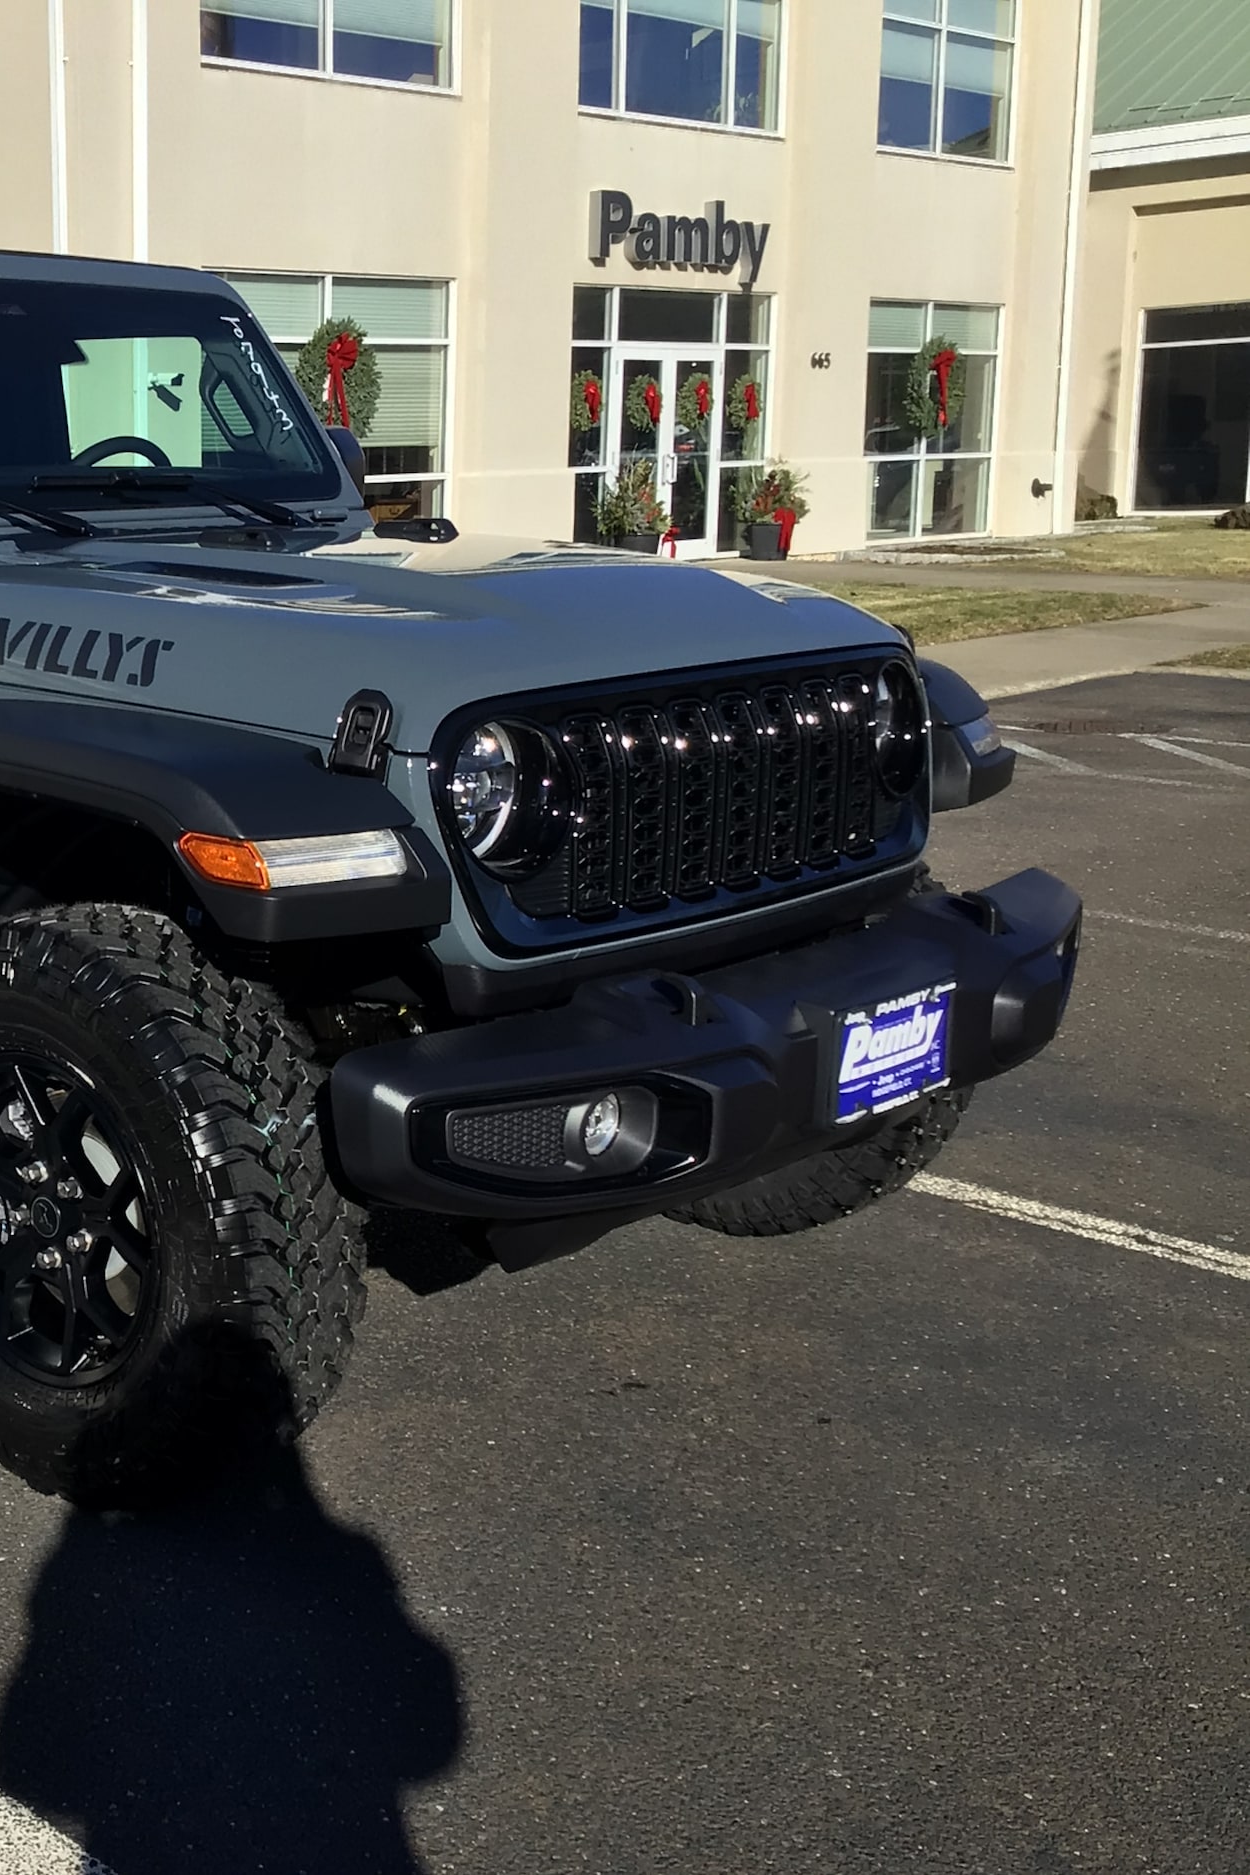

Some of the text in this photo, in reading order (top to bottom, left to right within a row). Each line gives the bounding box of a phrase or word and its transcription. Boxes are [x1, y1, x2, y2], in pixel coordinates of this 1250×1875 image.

[589, 190, 770, 284] Pamby
[811, 352, 831, 369] 665
[875, 988, 931, 1017] PAMBY
[838, 1005, 944, 1084] Pamby
